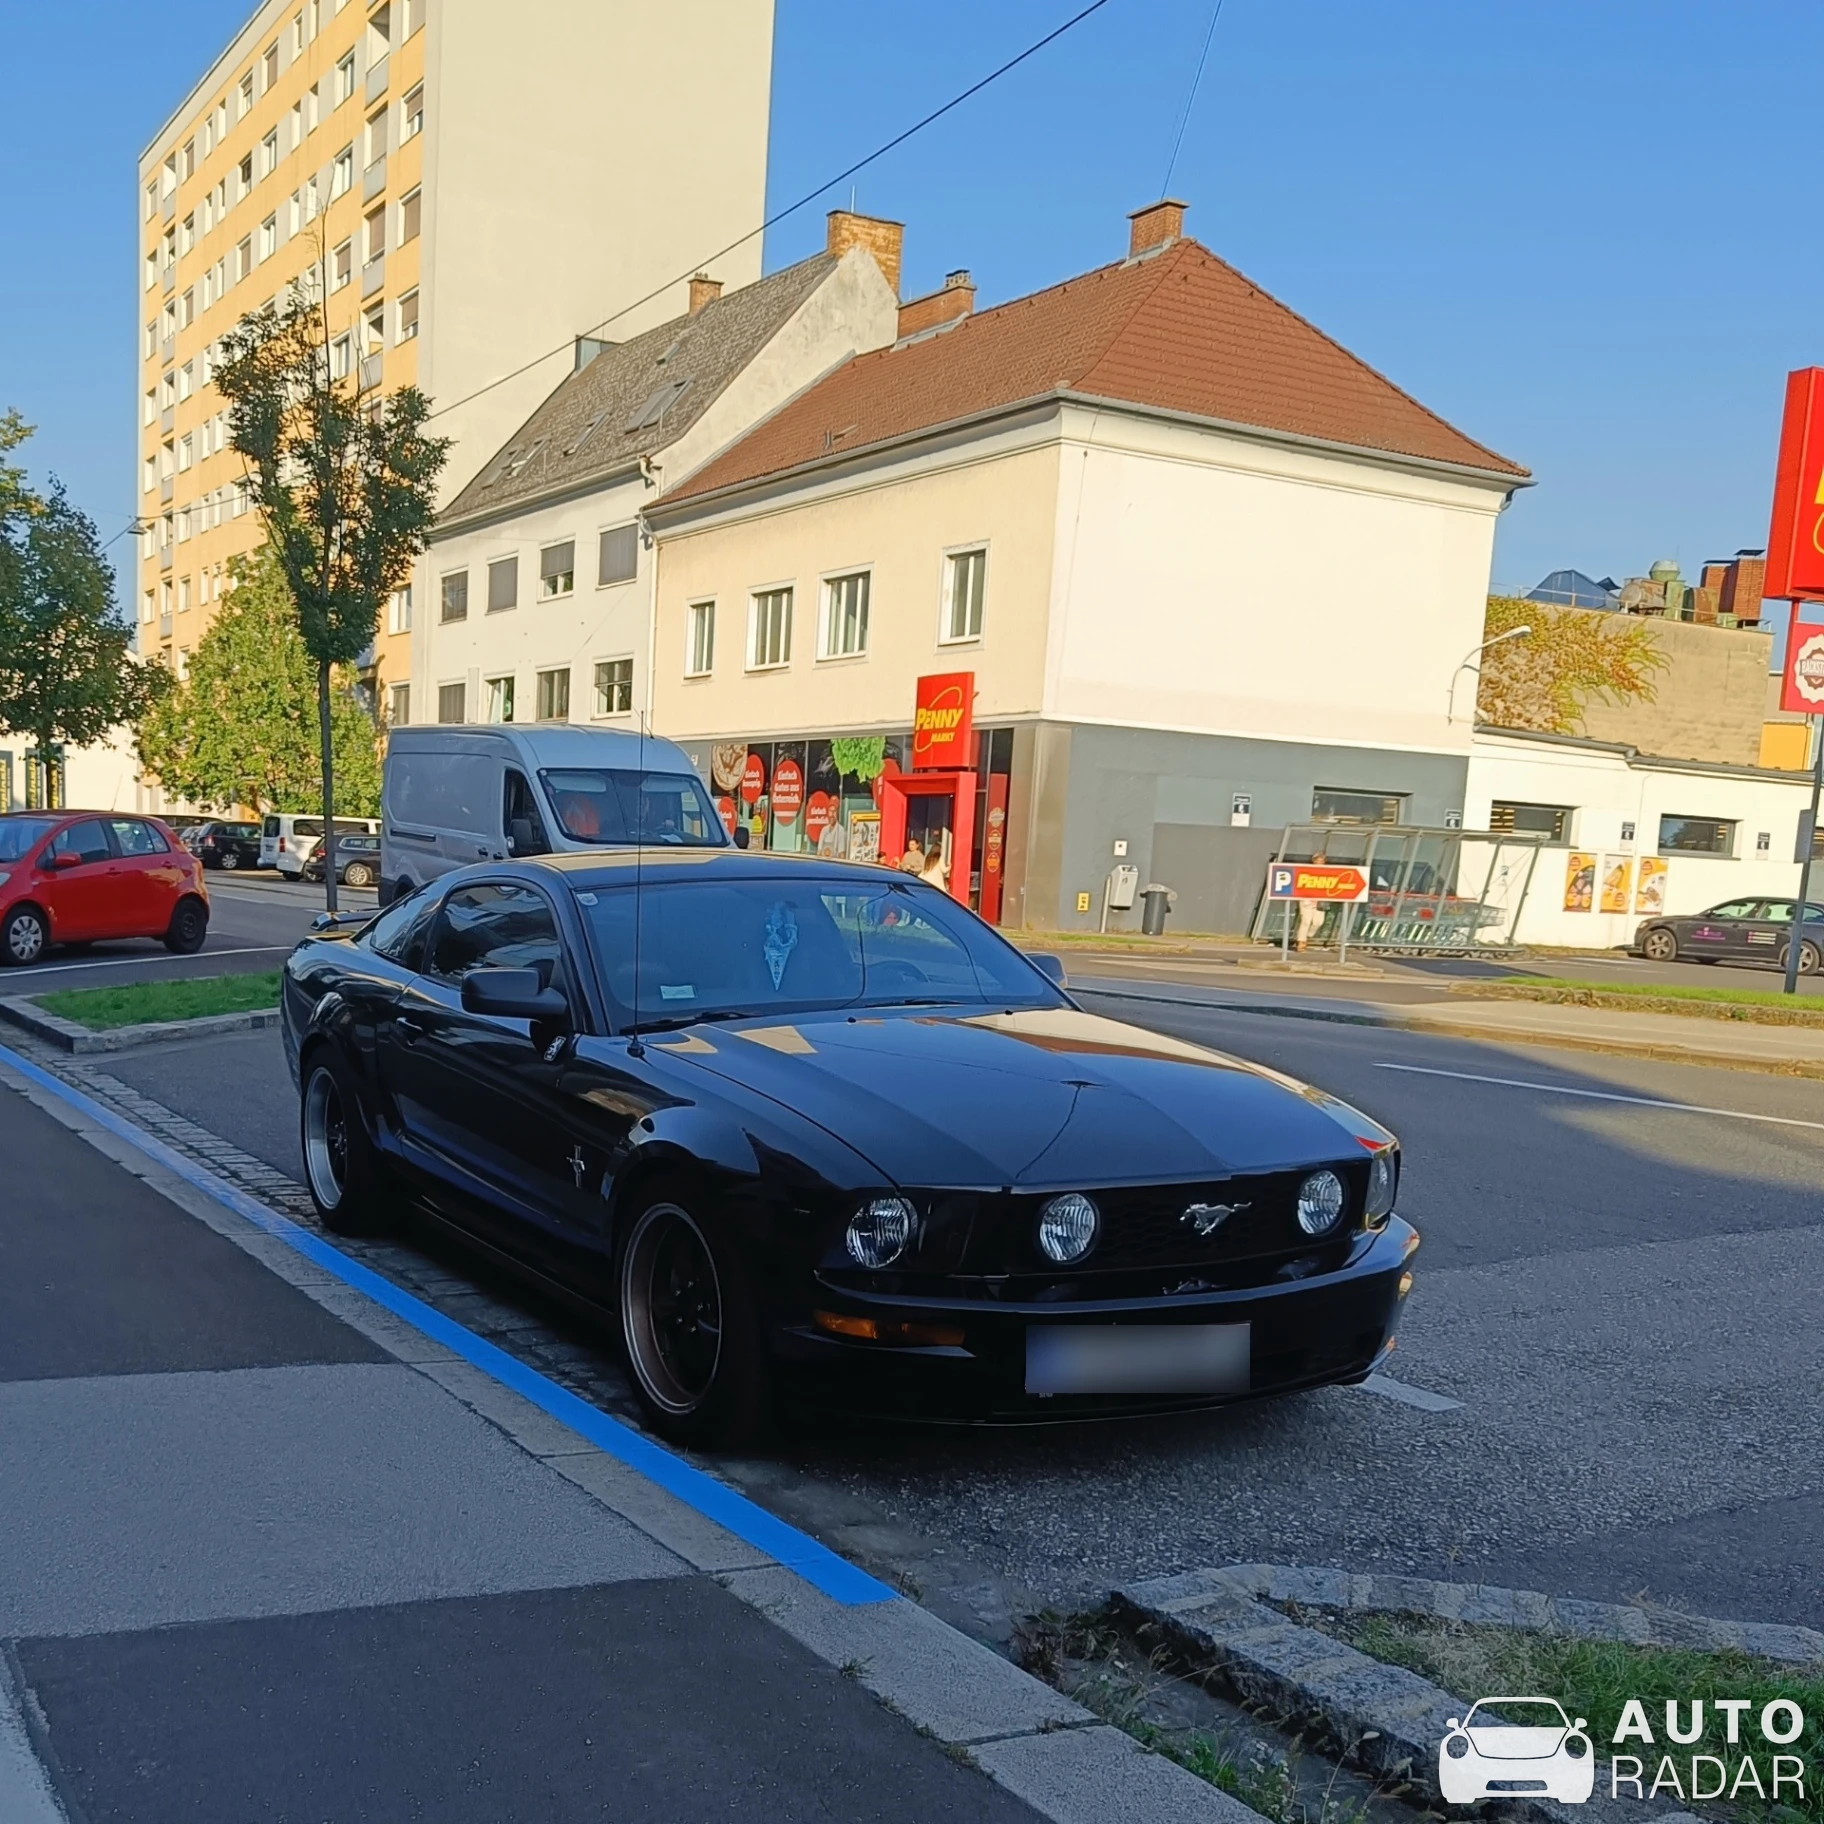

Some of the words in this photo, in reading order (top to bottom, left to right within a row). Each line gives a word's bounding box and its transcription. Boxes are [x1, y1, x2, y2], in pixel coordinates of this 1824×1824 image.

[915, 707, 964, 731] PENNY
[930, 732, 955, 742] MARKT
[1275, 871, 1292, 891] P
[1296, 873, 1338, 889] PENNY
